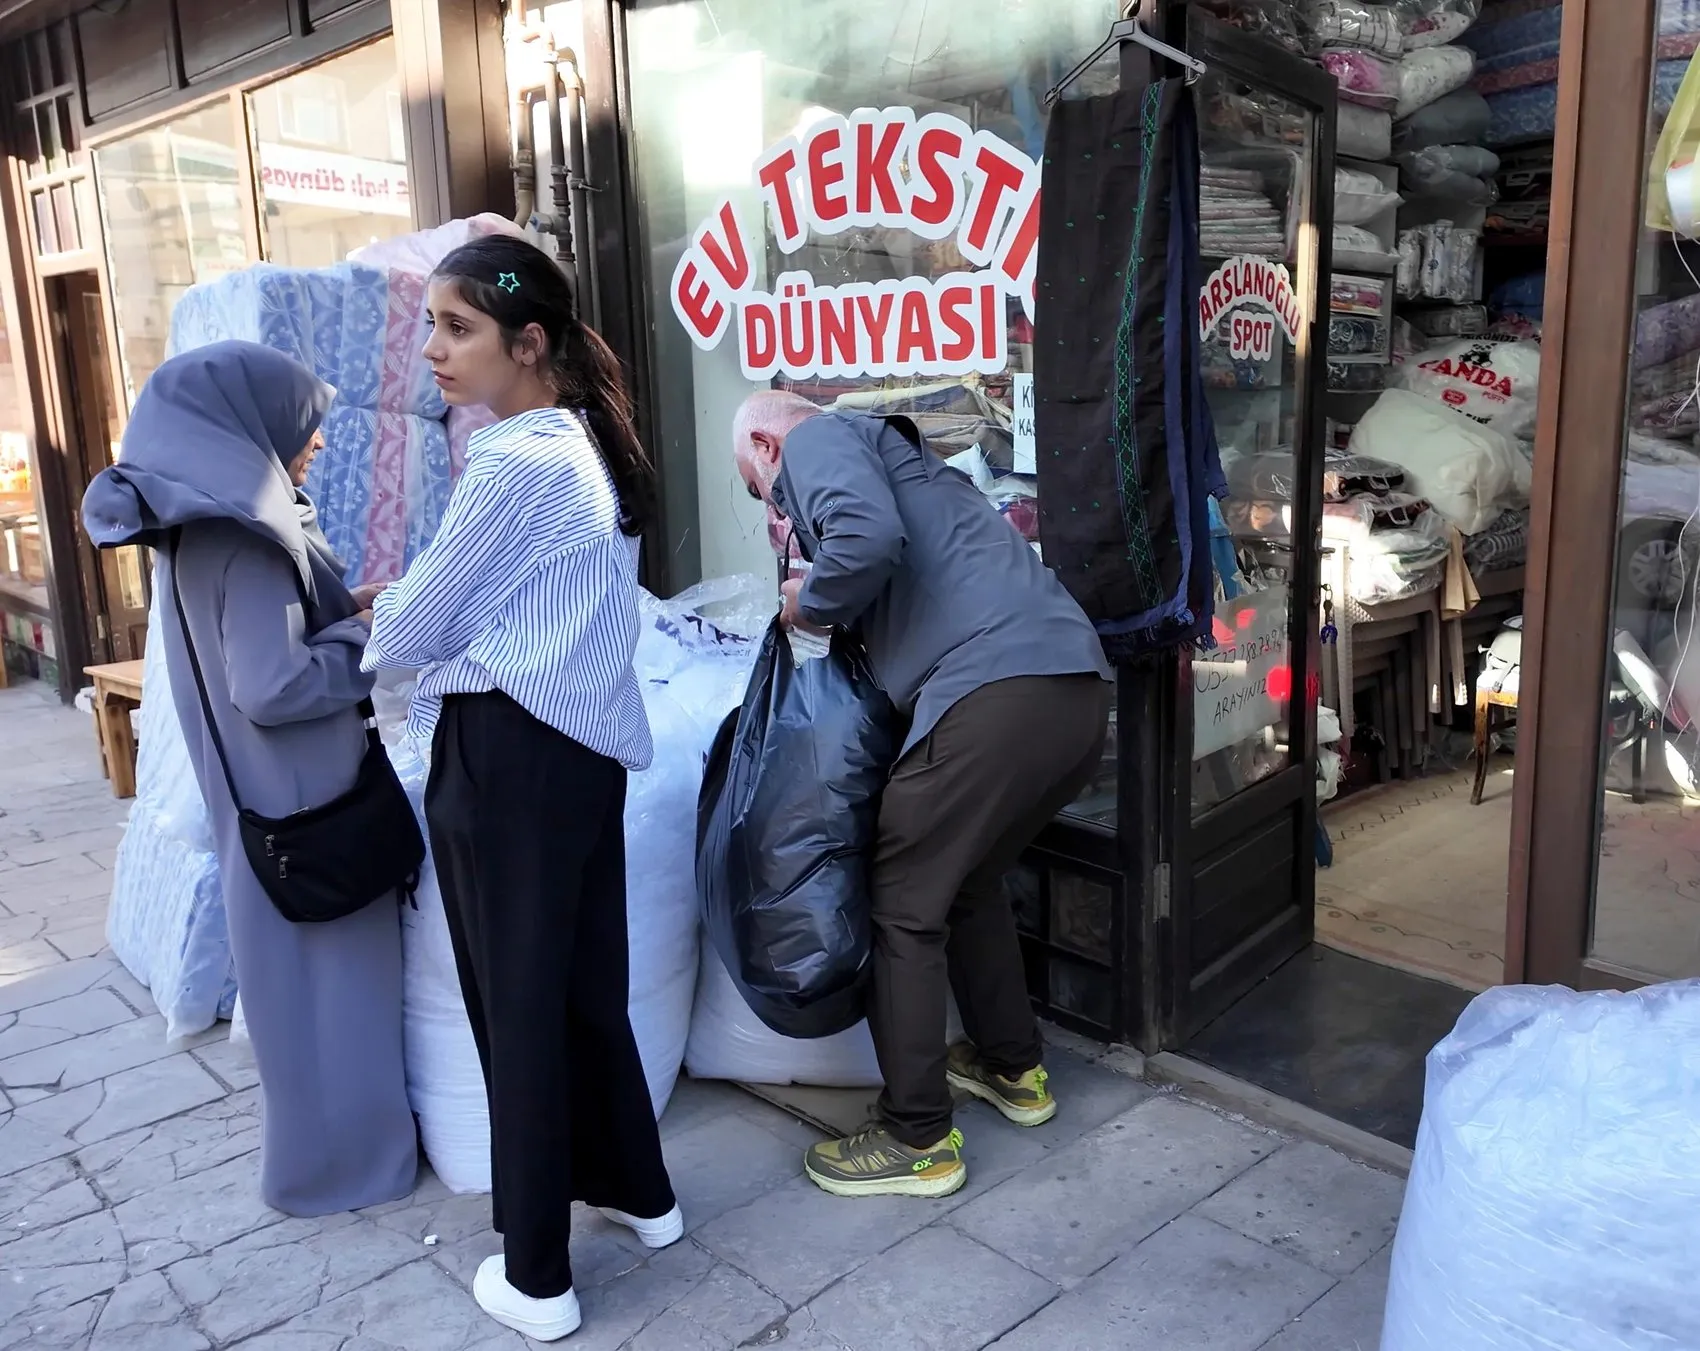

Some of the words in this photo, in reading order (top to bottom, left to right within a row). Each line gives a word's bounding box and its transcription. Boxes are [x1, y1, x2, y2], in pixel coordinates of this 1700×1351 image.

[677, 200, 749, 339] EV
[1200, 262, 1301, 338] ARSLANOĞLU
[744, 283, 998, 370] DÜNYASI
[1233, 318, 1272, 353] SPOT
